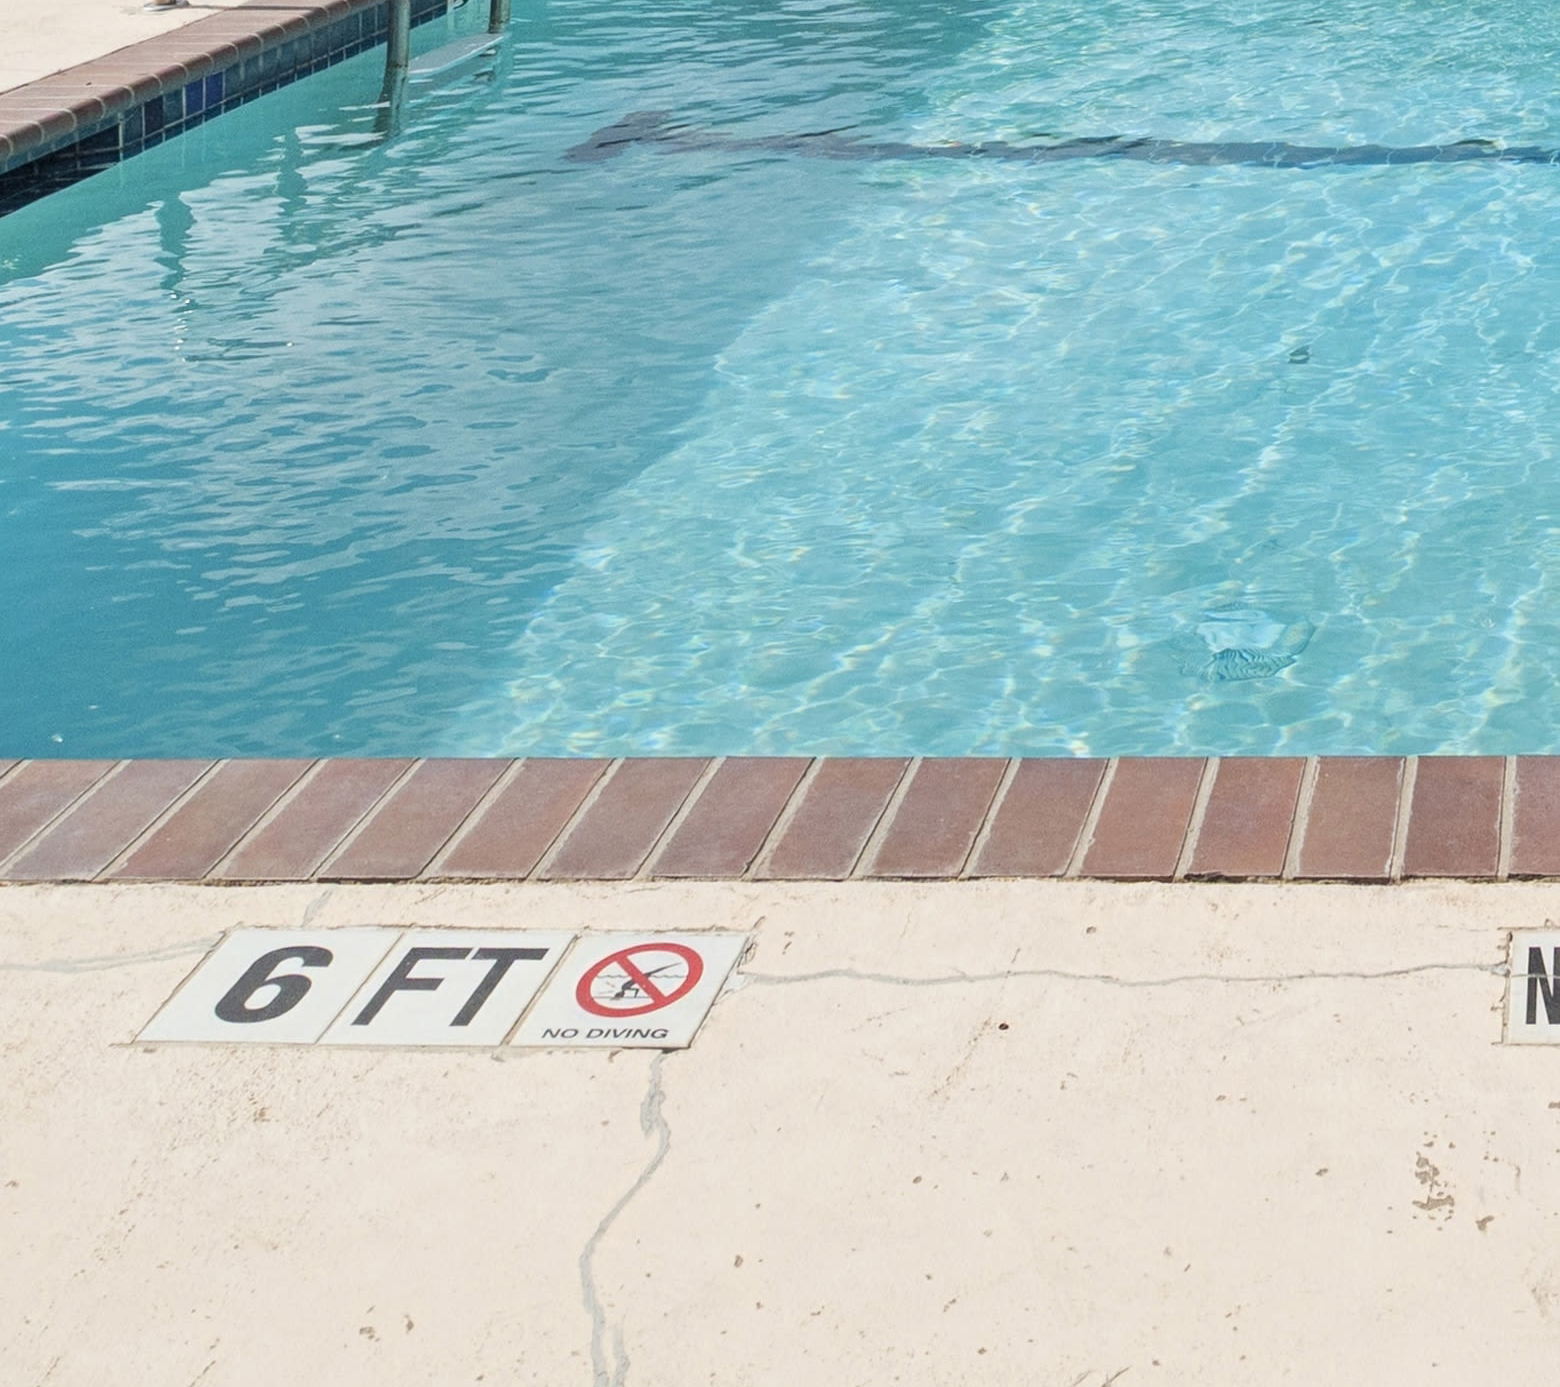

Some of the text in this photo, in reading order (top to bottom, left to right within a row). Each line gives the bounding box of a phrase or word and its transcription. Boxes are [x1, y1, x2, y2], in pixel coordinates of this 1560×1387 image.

[215, 946, 549, 1026] 6 FT
[542, 1028, 669, 1039] NO DIVING
